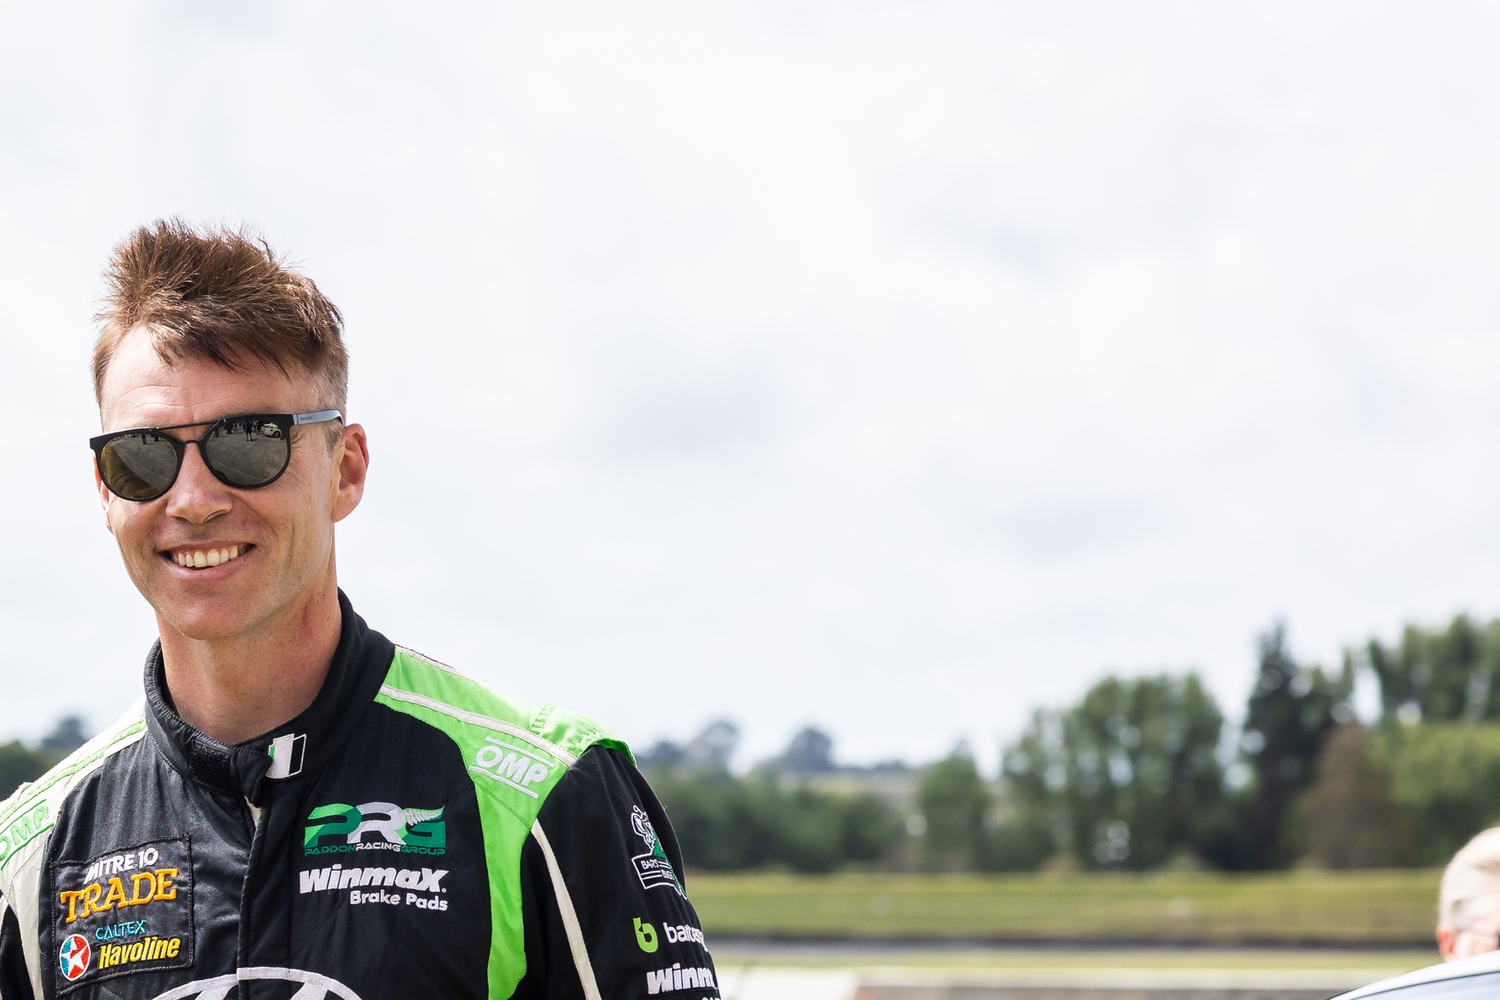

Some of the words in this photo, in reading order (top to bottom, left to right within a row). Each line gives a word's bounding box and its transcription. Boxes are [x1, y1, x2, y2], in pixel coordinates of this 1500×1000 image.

[476, 745, 548, 786] OMP
[303, 801, 446, 848] PRG
[83, 854, 135, 884] MITRE
[138, 847, 159, 868] 10
[60, 868, 179, 923] TRADE
[350, 890, 401, 905] Brake
[405, 893, 449, 911] Pads
[95, 919, 148, 941] CALTEX
[98, 936, 181, 970] Havoline
